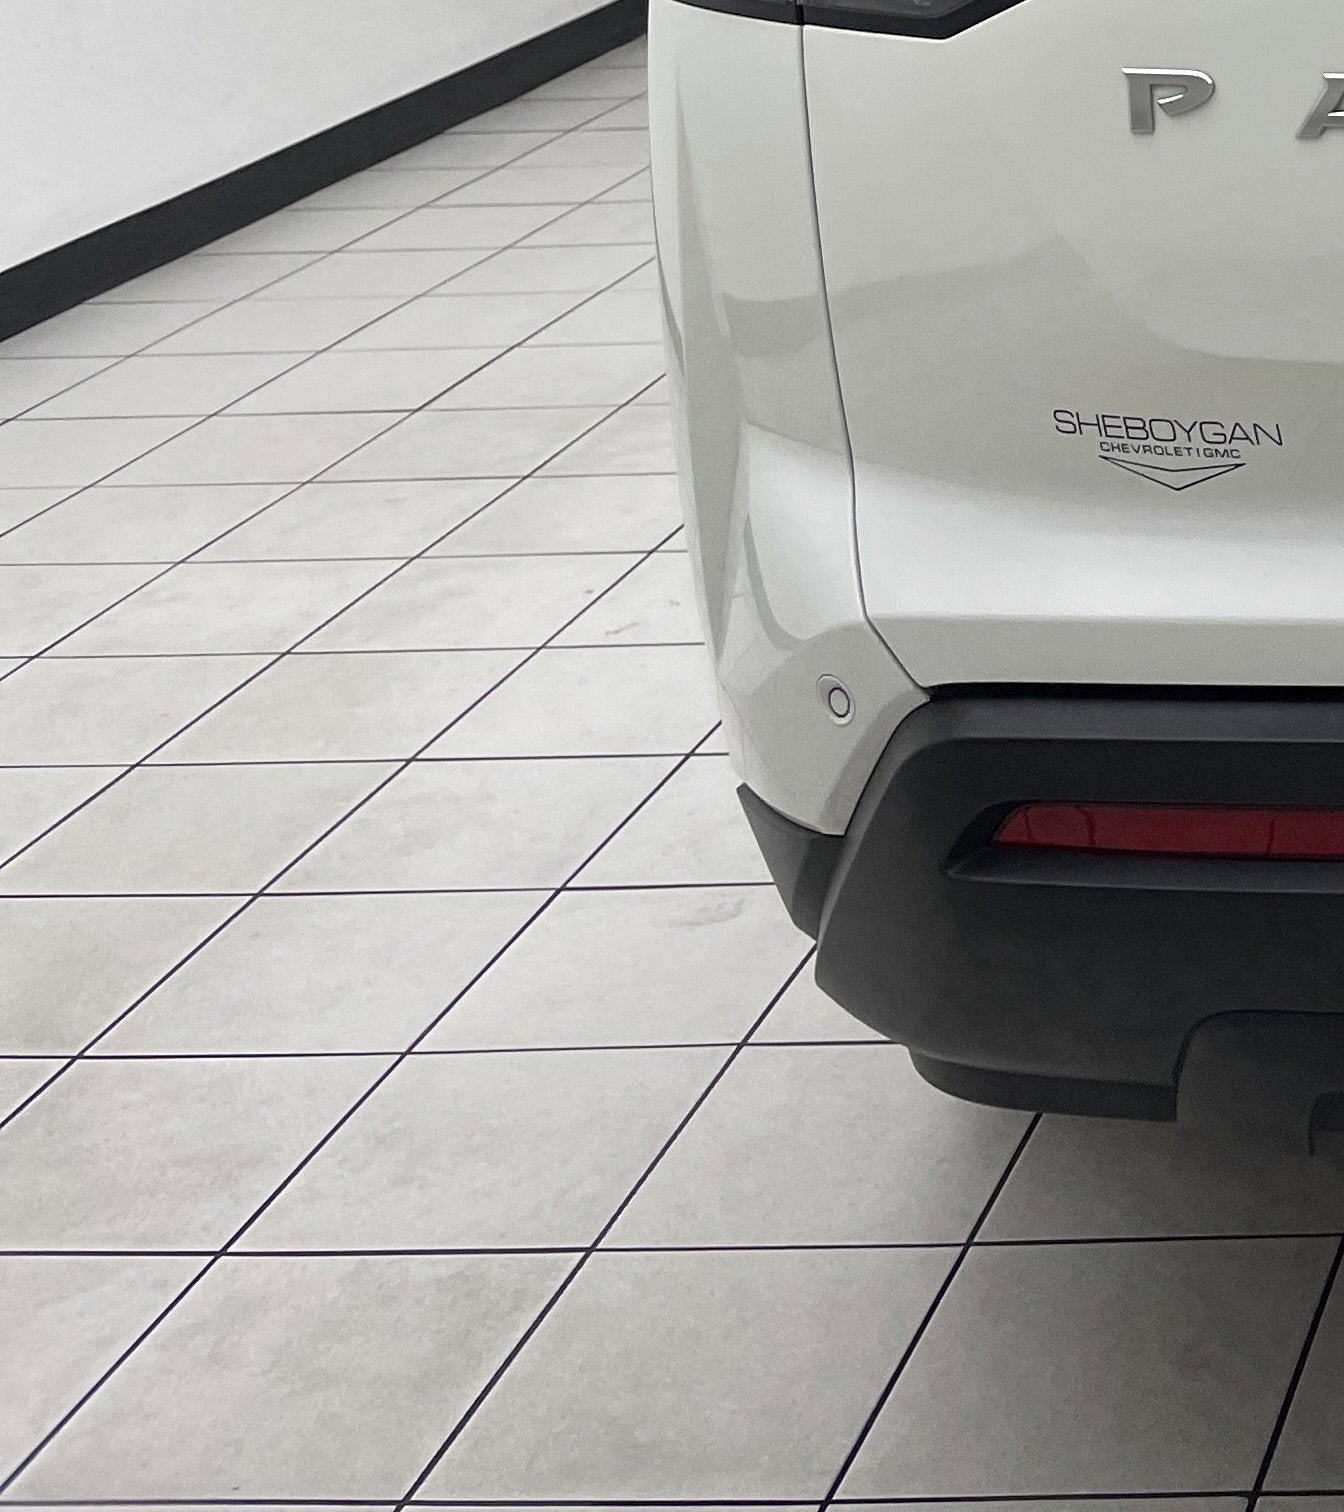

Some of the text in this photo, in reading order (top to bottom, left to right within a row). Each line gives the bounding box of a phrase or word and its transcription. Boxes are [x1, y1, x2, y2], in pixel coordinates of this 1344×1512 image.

[1052, 408, 1284, 447] SHEBOYGAN
[1099, 440, 1242, 459] CHEVROLET GMC
